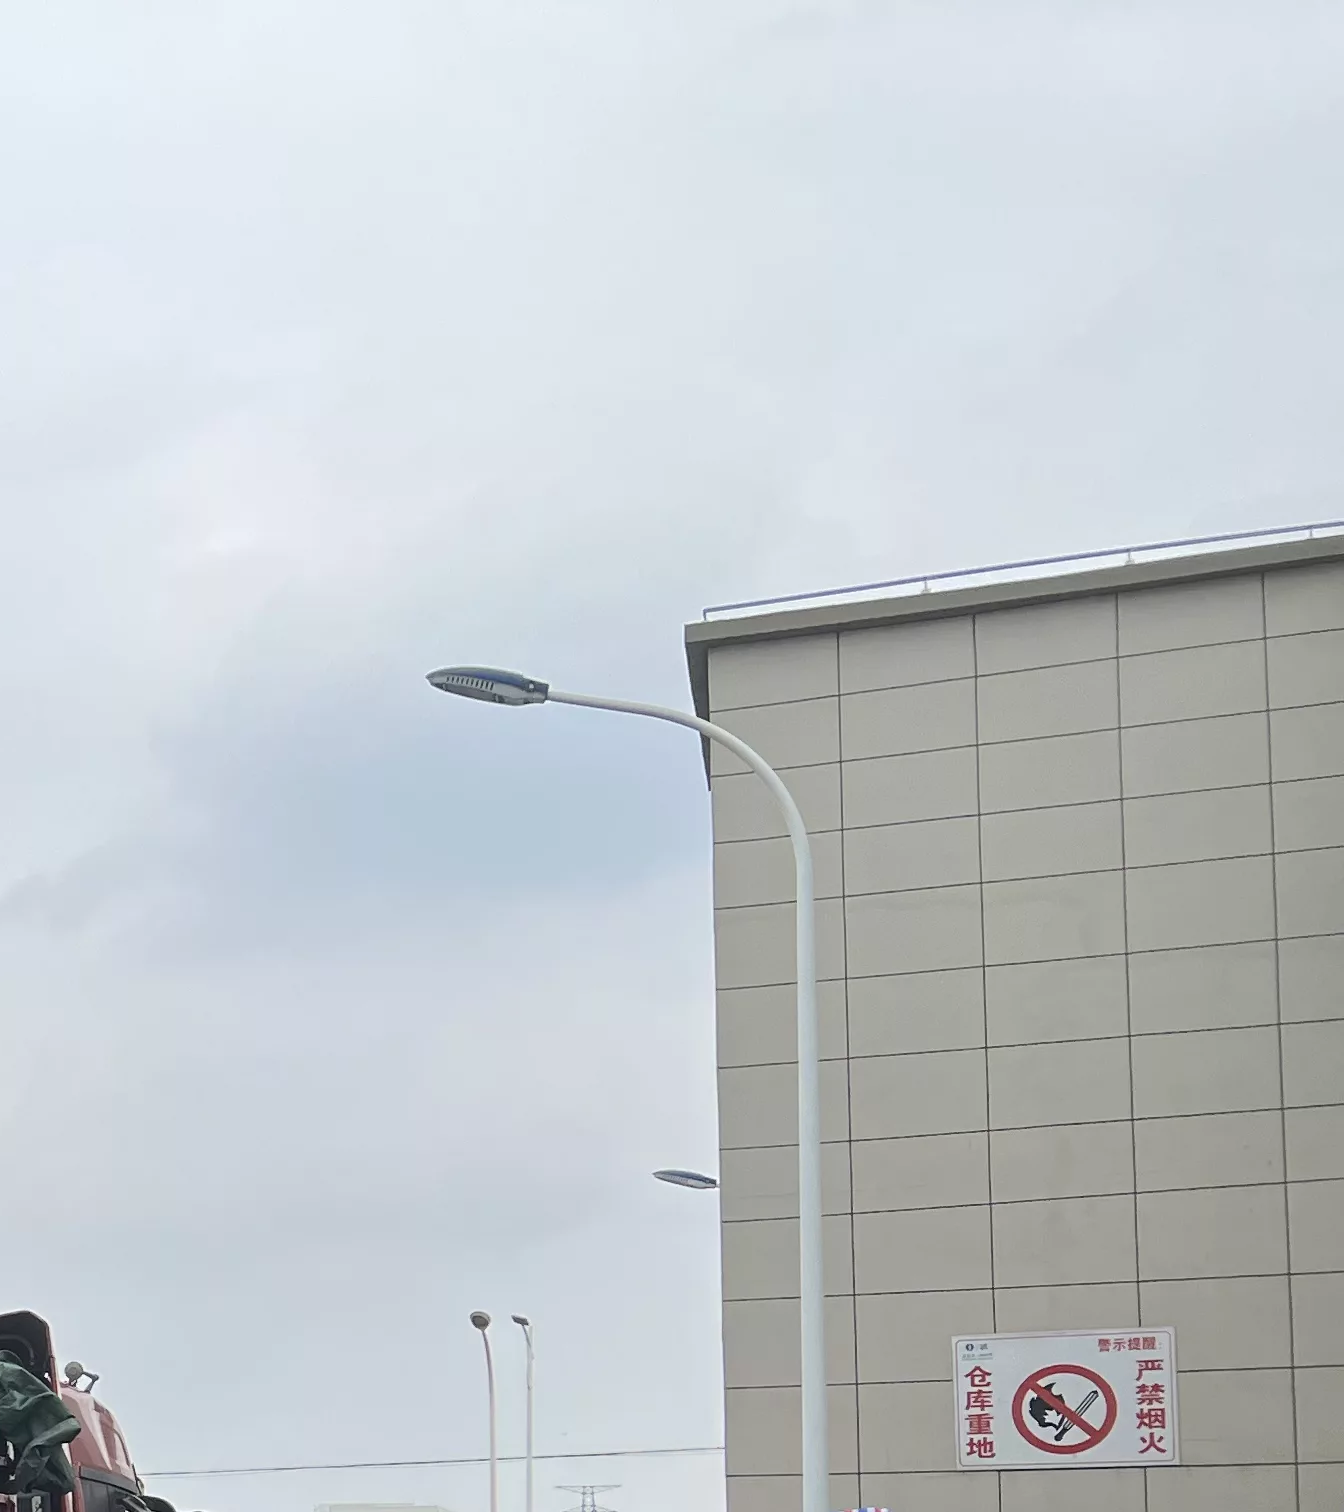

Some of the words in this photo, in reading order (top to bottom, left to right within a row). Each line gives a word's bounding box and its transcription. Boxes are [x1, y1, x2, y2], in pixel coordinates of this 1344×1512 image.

[964, 1366, 996, 1458] 仓库重地
[1136, 1359, 1166, 1454] 严禁烟火
